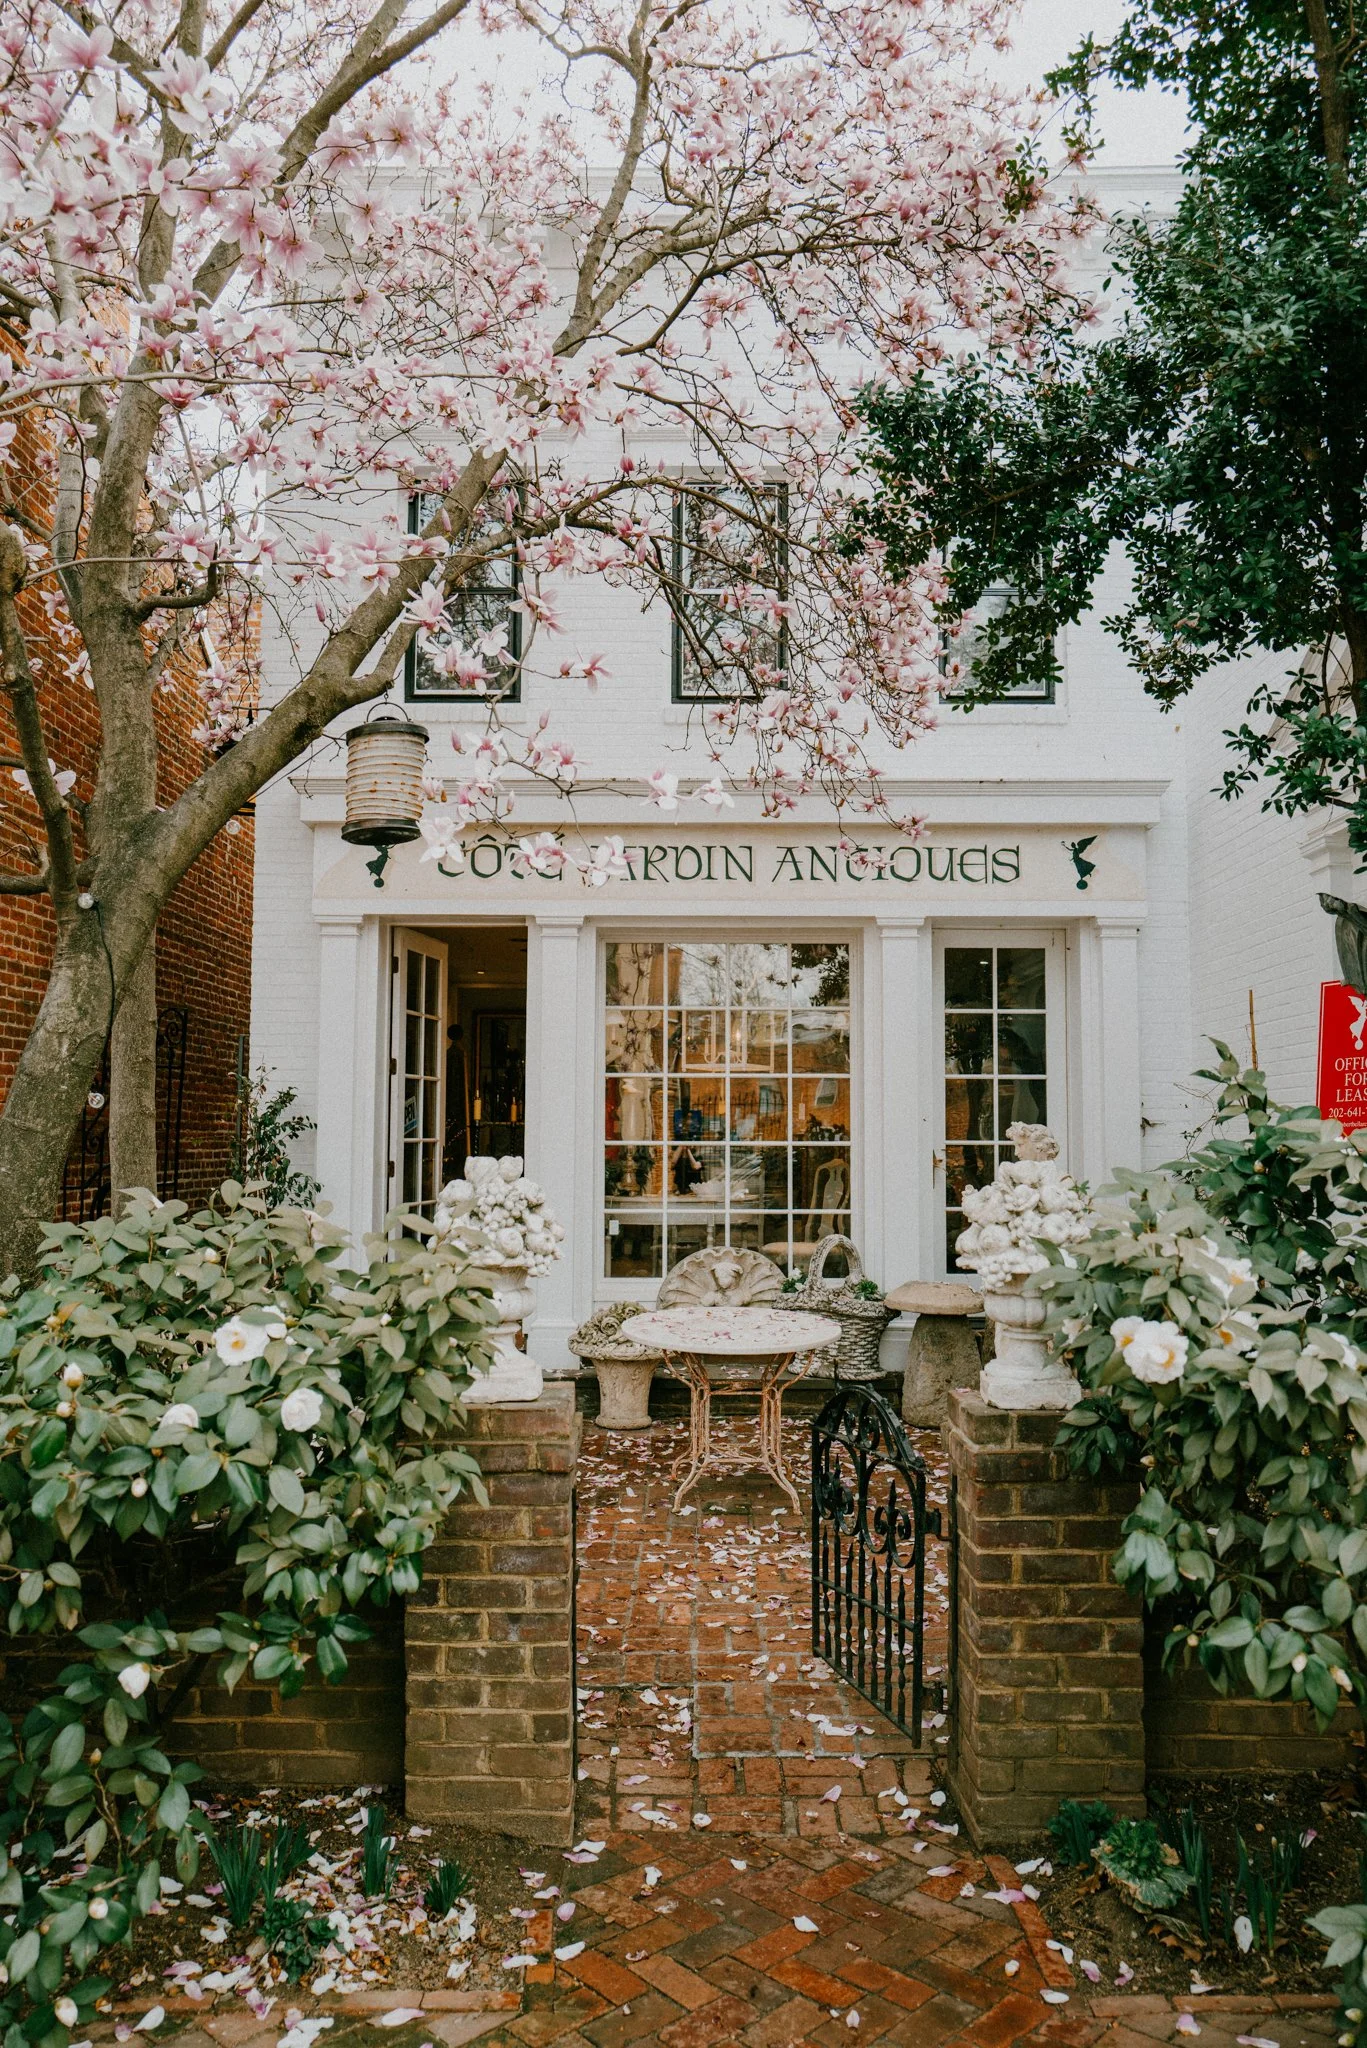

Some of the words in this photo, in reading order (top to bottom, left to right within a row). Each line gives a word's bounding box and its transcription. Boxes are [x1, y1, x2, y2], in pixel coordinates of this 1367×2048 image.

[590, 845, 754, 882] ARDIN
[772, 845, 1020, 883] ANTIQUES
[1335, 1057, 1367, 1071] OFFI
[1328, 1107, 1367, 1118] 202-641-
